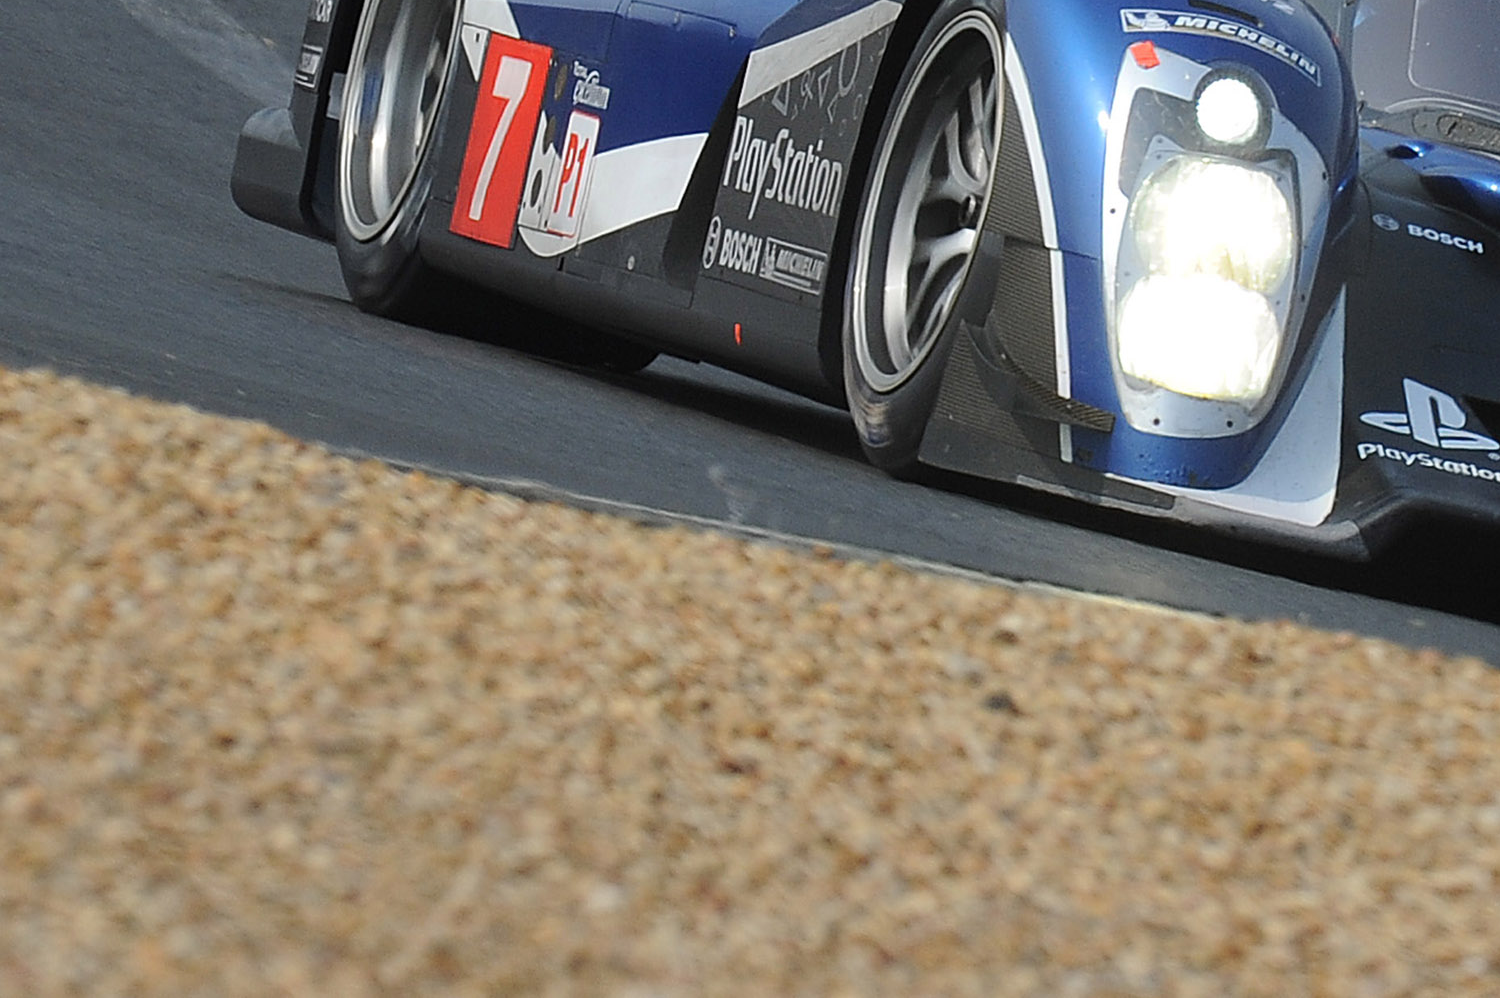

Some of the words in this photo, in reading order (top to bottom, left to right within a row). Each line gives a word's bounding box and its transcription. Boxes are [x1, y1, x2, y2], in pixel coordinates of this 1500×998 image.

[1174, 15, 1317, 75] MICHELIN
[468, 54, 533, 221] 7
[722, 115, 843, 220] PlayStation
[554, 133, 590, 217] P1
[719, 228, 763, 275] BOSCH
[1407, 223, 1484, 254] BOSCH
